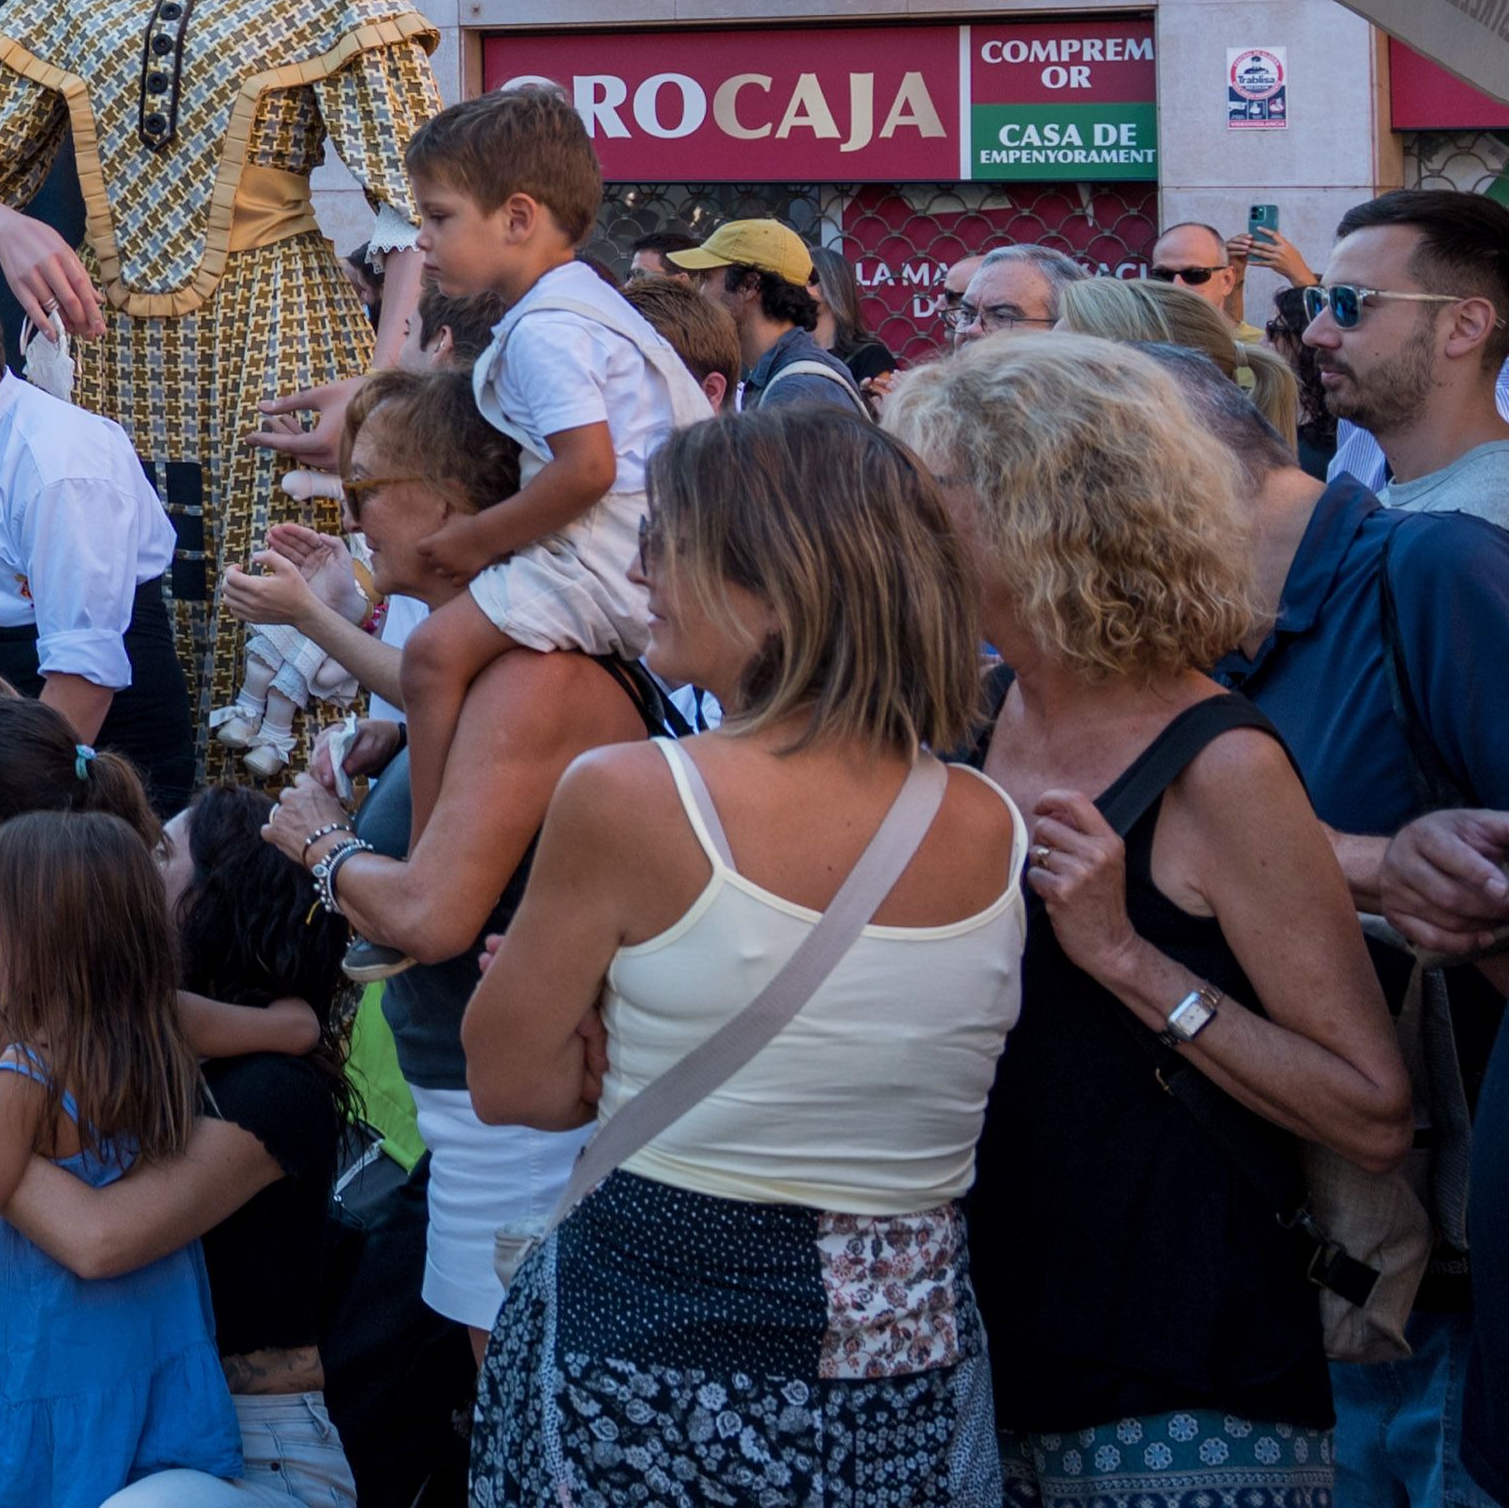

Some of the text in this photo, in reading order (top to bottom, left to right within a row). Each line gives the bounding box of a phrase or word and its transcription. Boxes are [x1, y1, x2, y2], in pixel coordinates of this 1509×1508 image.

[981, 38, 1154, 63] COMPREM
[1041, 66, 1092, 89] OR
[1237, 74, 1276, 84] Trablisa
[999, 123, 1137, 147] CASA DE
[980, 148, 1156, 164] EMPENYORAMENT
[855, 263, 895, 286] LA
